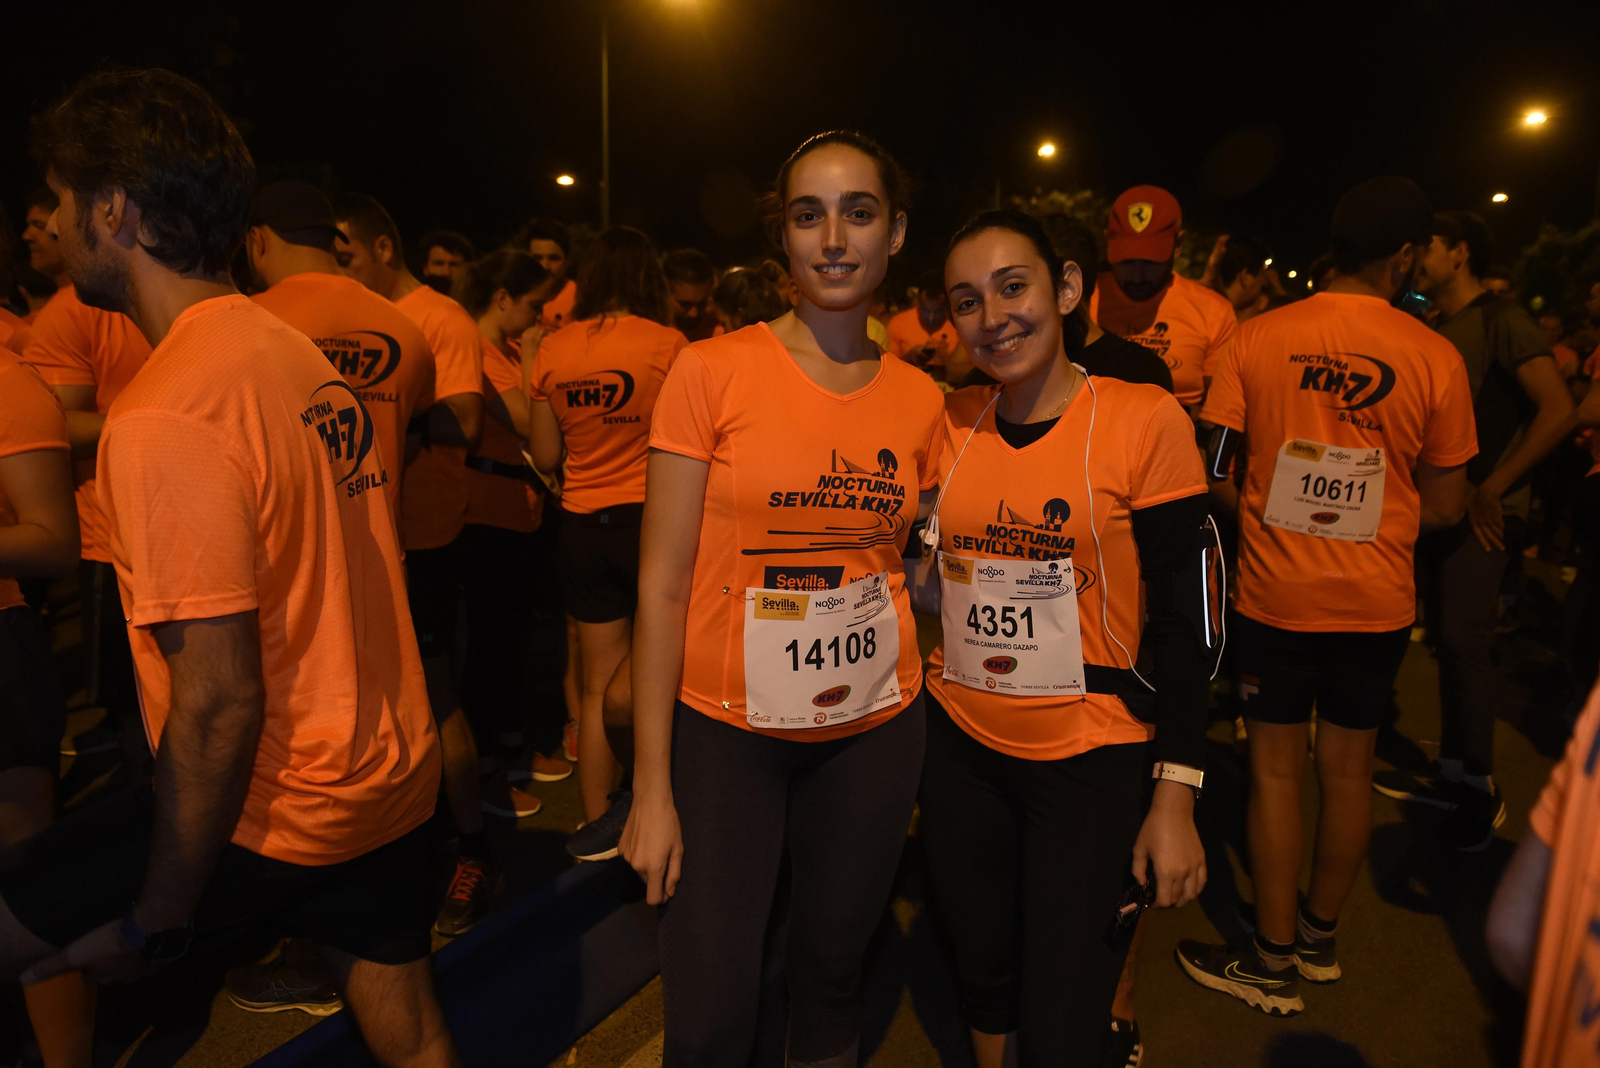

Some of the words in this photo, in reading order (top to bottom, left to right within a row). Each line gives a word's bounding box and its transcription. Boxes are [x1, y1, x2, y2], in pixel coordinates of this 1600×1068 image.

[556, 379, 600, 389] NOCTURNA
[602, 415, 641, 425] SEVILLA
[817, 475, 905, 498] NOCTURNA
[1301, 473, 1367, 503] 10611
[768, 492, 857, 510] SEVILLA
[953, 535, 1025, 558] SEVILLA
[986, 523, 1075, 550] NOCTURNA
[776, 573, 830, 588] Sevilla.
[967, 604, 1034, 639] 4351
[785, 627, 876, 671] 14108
[964, 637, 980, 647] NEREA
[980, 641, 1012, 650] CAMARERO
[1013, 643, 1039, 651] GAZAPO
